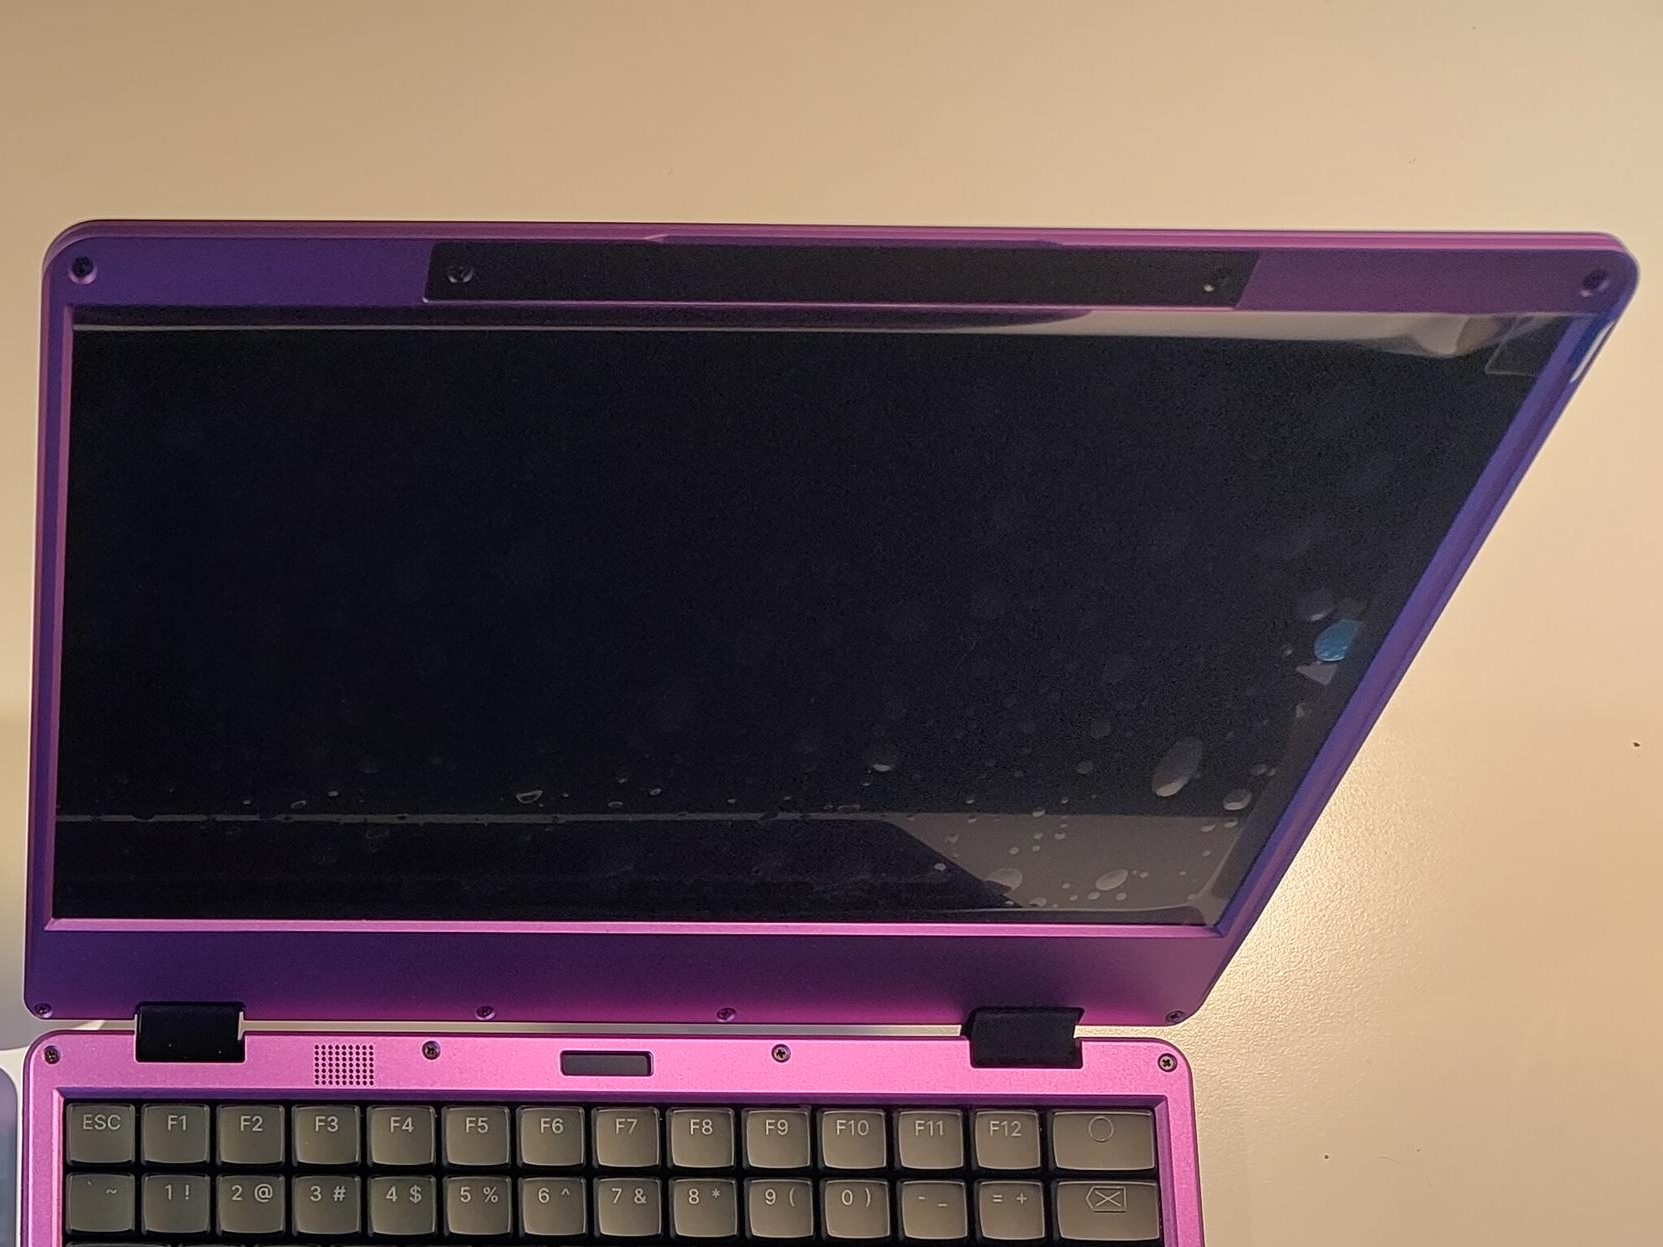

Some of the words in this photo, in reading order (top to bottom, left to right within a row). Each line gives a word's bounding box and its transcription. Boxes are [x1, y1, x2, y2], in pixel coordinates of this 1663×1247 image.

[82, 1114, 120, 1131] ESC
[168, 1115, 187, 1131] F1
[241, 1116, 263, 1132] F2
[315, 1116, 338, 1132] F3
[391, 1117, 413, 1133] F4
[466, 1118, 488, 1133] F5
[540, 1119, 563, 1134] F6
[616, 1119, 637, 1135] F7
[690, 1119, 713, 1135] F8
[766, 1120, 788, 1136] F9
[836, 1120, 869, 1136] F10
[916, 1121, 944, 1137] F11
[990, 1121, 1021, 1137] F12
[231, 1185, 242, 1201] 2
[310, 1186, 322, 1202] 3
[386, 1187, 397, 1202] 4
[460, 1187, 471, 1203] 5
[538, 1188, 549, 1204] 6
[612, 1188, 621, 1204] 7
[688, 1189, 699, 1205] 8
[765, 1189, 776, 1205] 9
[841, 1190, 853, 1206] 0
